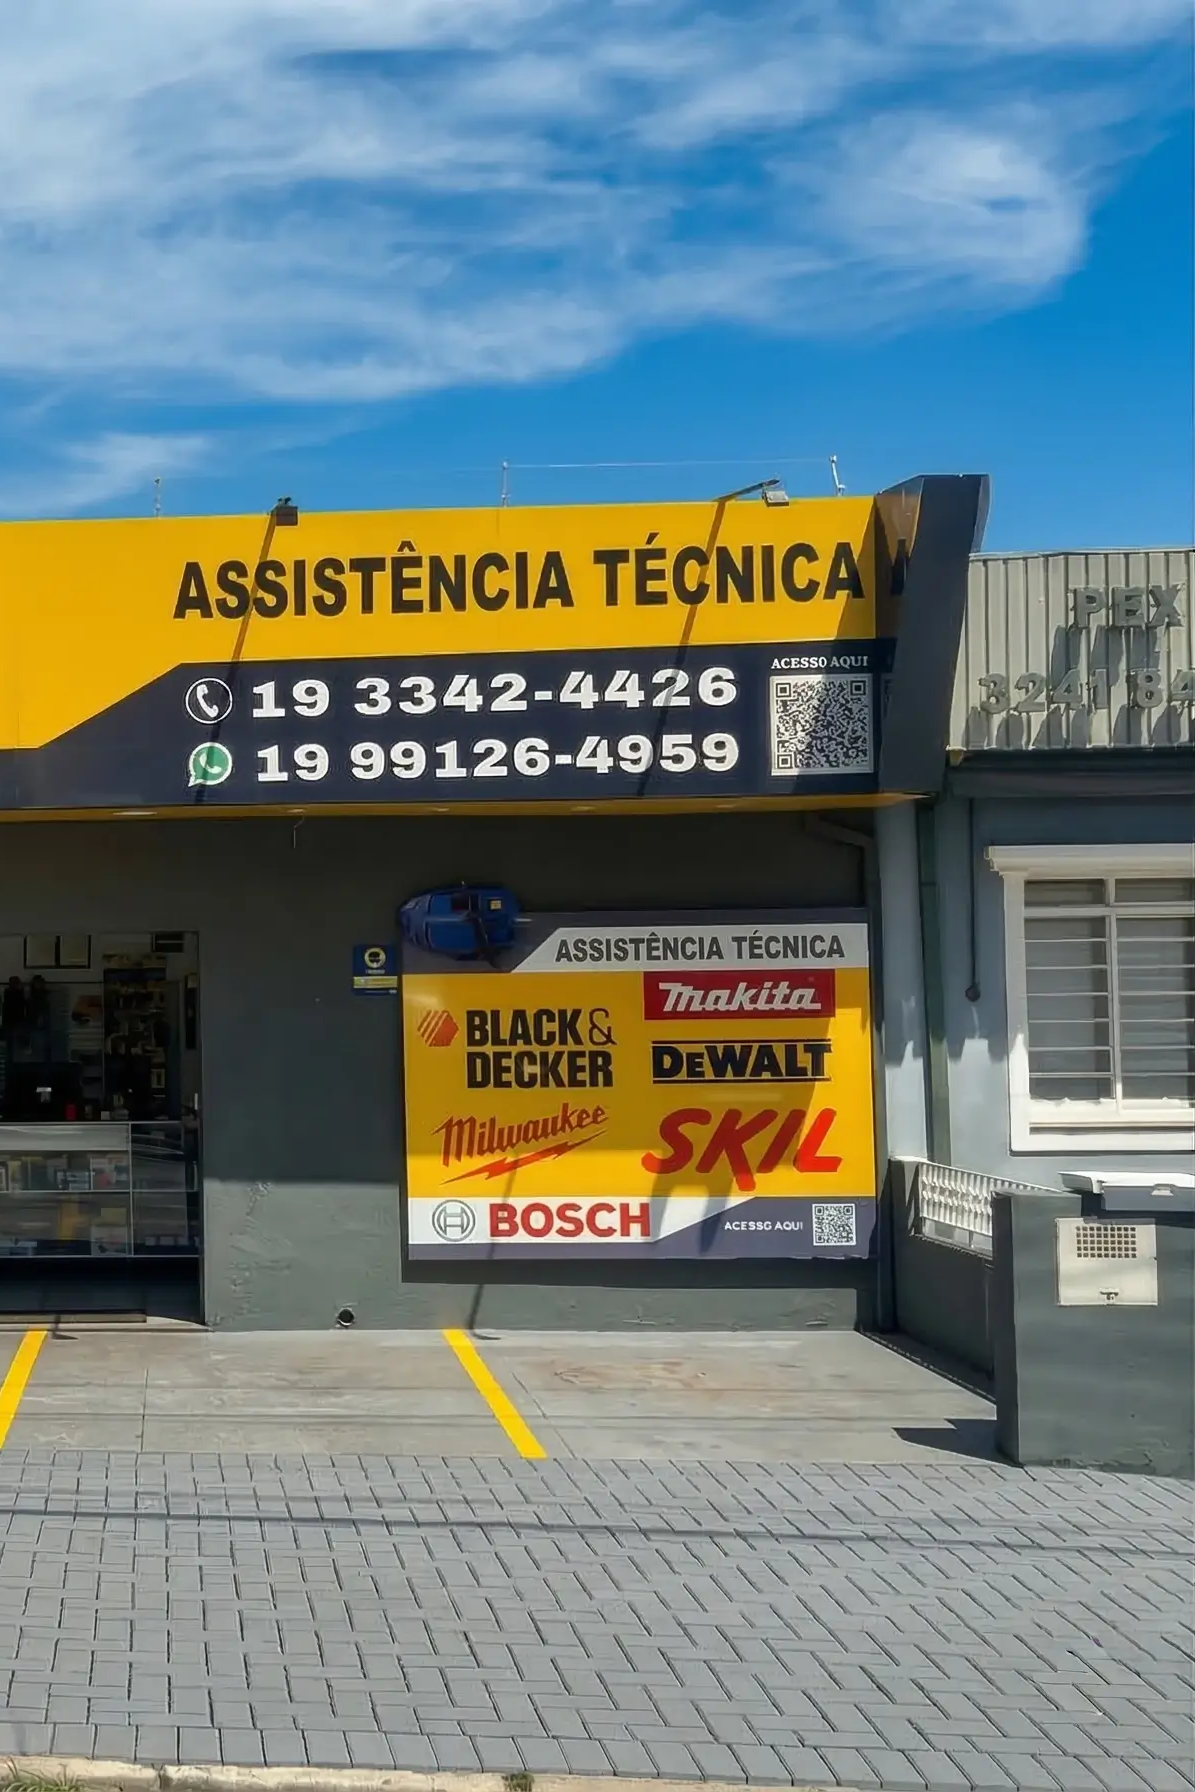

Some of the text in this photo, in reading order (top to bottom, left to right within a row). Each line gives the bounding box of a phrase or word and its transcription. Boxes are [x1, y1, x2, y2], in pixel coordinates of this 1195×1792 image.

[172, 532, 865, 619] ASSISTÊNCIA TÉCNICA
[1072, 584, 1184, 628] PEX
[770, 656, 869, 669] ACESSO AQUI
[251, 667, 737, 718] 19 3342-4426
[257, 733, 739, 782] 19 99126-4959
[555, 930, 845, 963] ASSISTÊNCIA TÉCNICA
[659, 981, 822, 1012] Makita
[466, 1008, 617, 1047] BLACK &
[467, 1050, 613, 1088] DECKER
[431, 1103, 609, 1167] Milwaukee
[641, 1107, 843, 1191] SKIL
[489, 1203, 650, 1238] BOSCH
